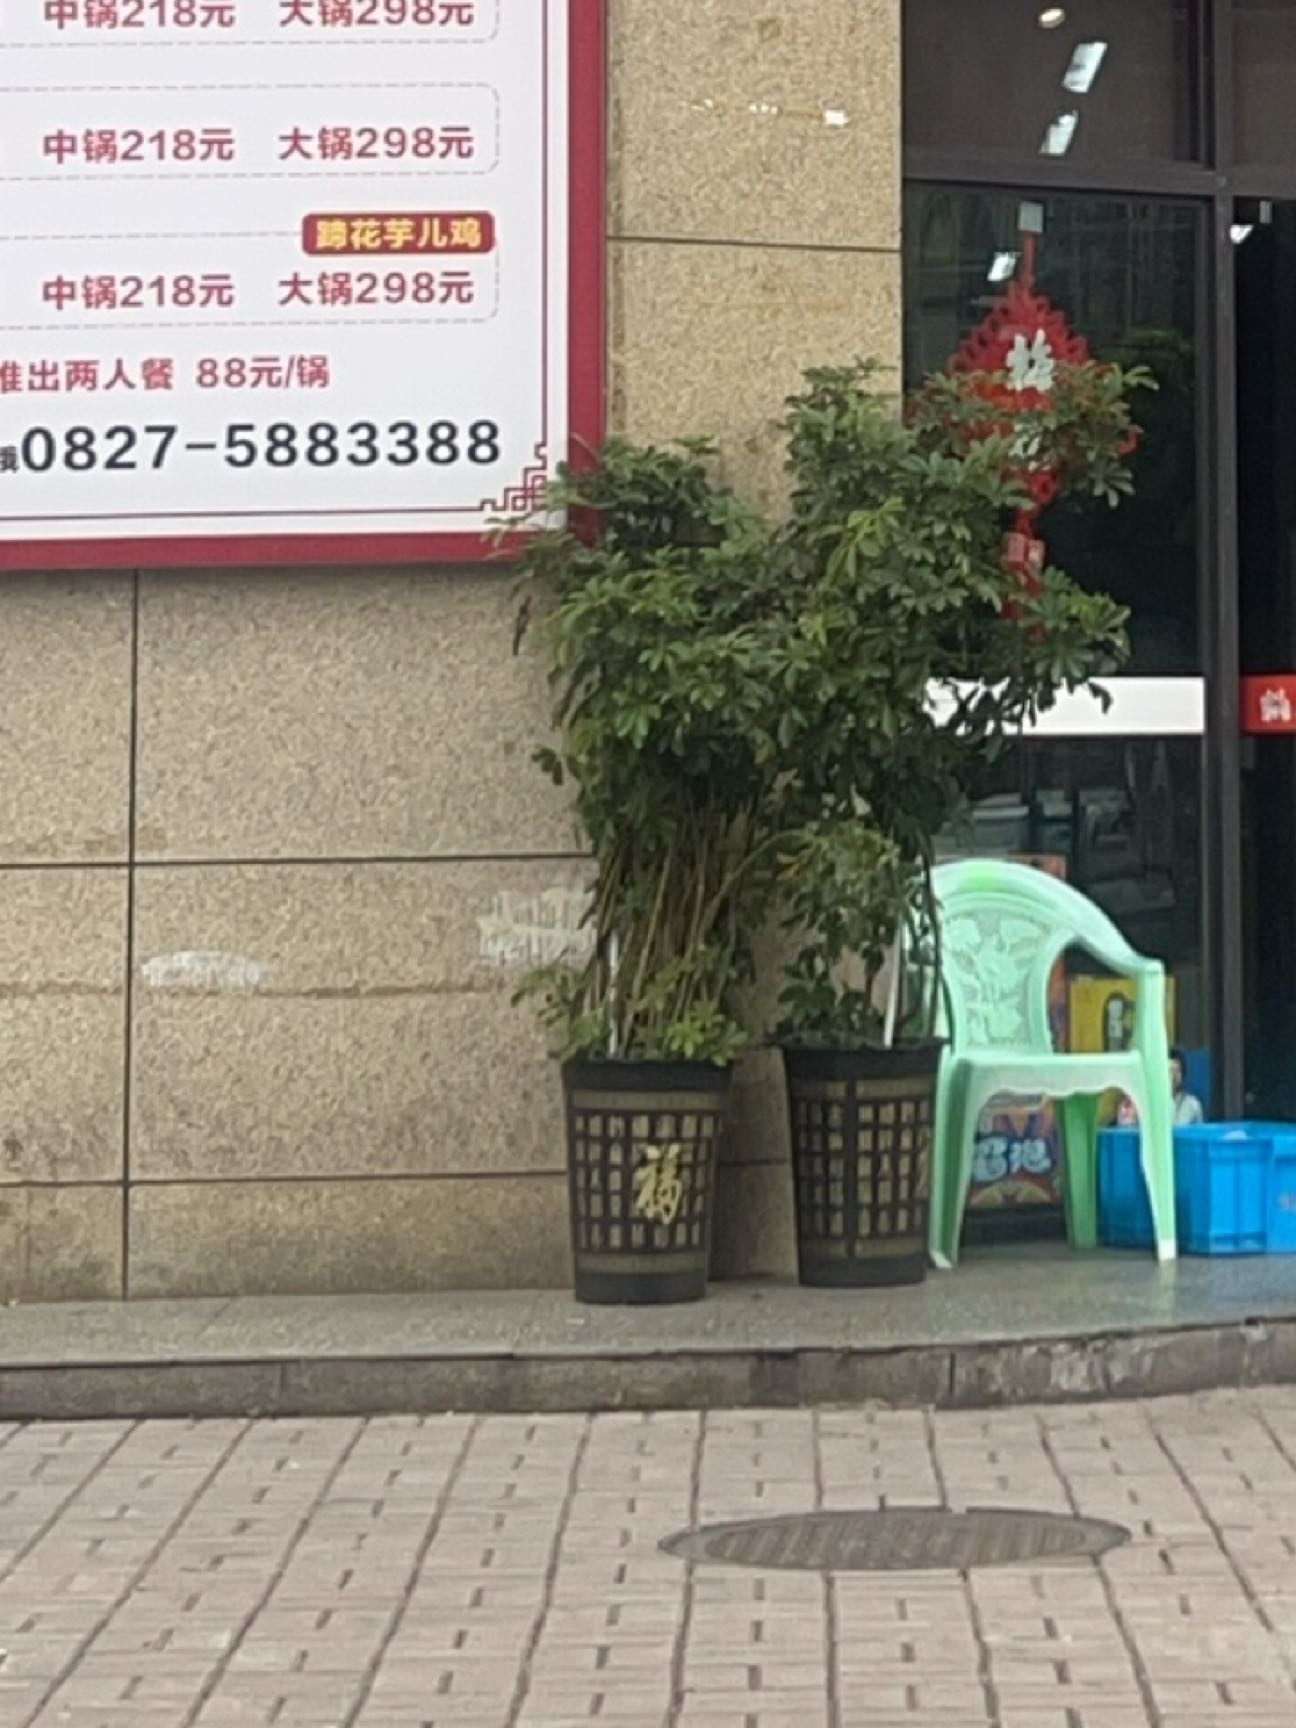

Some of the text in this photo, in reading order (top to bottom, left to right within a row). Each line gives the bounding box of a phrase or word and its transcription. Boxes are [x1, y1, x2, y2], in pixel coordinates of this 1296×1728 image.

[43, 127, 474, 164] 中锅218元 大锅298元
[316, 217, 482, 249] 蹄花芋儿鸡
[43, 272, 474, 310] 中锅218元 大锅298元
[196, 355, 330, 390] 88元/锅
